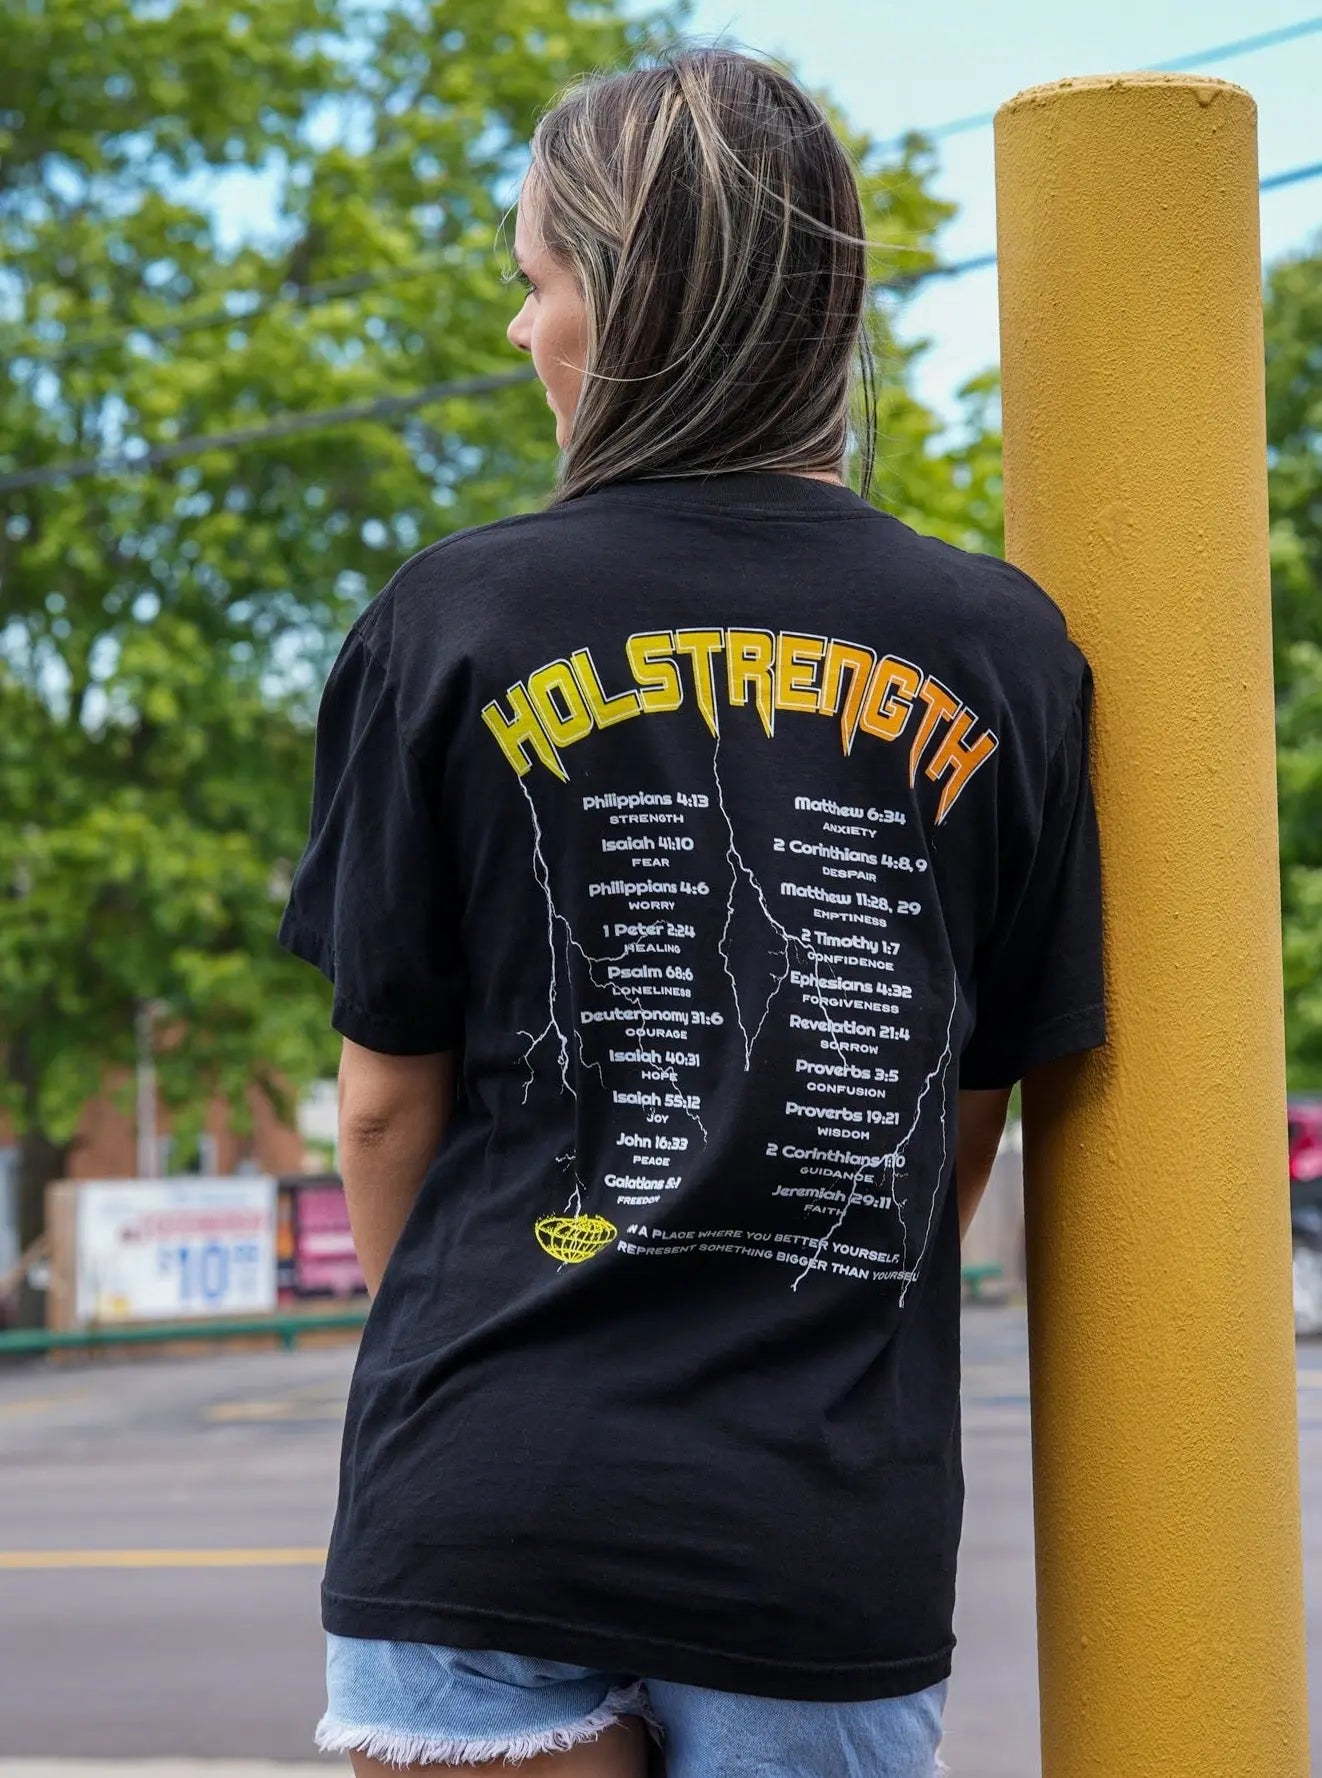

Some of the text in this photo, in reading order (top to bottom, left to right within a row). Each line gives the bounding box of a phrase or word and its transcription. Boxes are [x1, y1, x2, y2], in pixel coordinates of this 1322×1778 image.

[583, 791, 709, 810] Philippians 4:13
[609, 814, 684, 824] STRENGTH
[795, 796, 906, 825] Matthew 6:34
[823, 822, 877, 838] ANXIETY
[602, 836, 694, 852] Isaiah 41:10
[632, 858, 670, 867] FEAR
[773, 838, 928, 872] 2 Corinthians 4:8, 9
[822, 866, 877, 883] DESPAIR
[589, 880, 710, 897] Philippians 4:6
[629, 901, 675, 910] WORRY
[780, 882, 922, 916] Matthew 11:28, 29
[813, 908, 887, 928] EMPTINESS
[603, 922, 696, 938] 1 Peter 2:24
[624, 944, 681, 954] HEALING
[801, 928, 900, 956] 2 Timothy 1:7
[807, 952, 895, 971] CONFIDENCE
[608, 965, 694, 981] Psalm 68:6
[612, 986, 692, 998] LONELINESS
[790, 970, 913, 999] Ephesians 4:32
[802, 994, 900, 1015] FORGIVENESS
[580, 1008, 724, 1026] Deuteronomy 31:6
[625, 1028, 688, 1040] COURAGE
[789, 1014, 911, 1042] Revelation 21:4
[820, 1039, 879, 1055] SORROW
[609, 1049, 700, 1067] Isaiah 40:31
[641, 1070, 678, 1082] HOPE
[795, 1058, 899, 1083] Proverbs 3:5
[806, 1082, 886, 1099] CONFUSION
[612, 1090, 701, 1110] Isaiah 55:12
[646, 1114, 669, 1124] JOY
[785, 1101, 900, 1125] Proverbs 19:21
[616, 1132, 689, 1150] John 16:33
[817, 1126, 870, 1141] WISDOM
[632, 1154, 671, 1167] PEACE
[765, 1142, 778, 1157] 2
[782, 1145, 880, 1168] Corinthians
[604, 1174, 665, 1190] Galatians
[800, 1166, 875, 1184] GUIDANCE
[772, 1185, 892, 1210] Jeremiah 29:11
[803, 1204, 847, 1217] FAITH
[638, 1225, 648, 1238] A
[652, 1228, 696, 1240] PLACE
[698, 1230, 743, 1239] WHERE
[746, 1231, 772, 1242] YOU
[774, 1233, 829, 1251] BETTER
[832, 1242, 900, 1264] YOURSELF,
[617, 1240, 697, 1256] REPRESENT
[698, 1243, 773, 1259] SOMETHING
[776, 1251, 827, 1271] BIGGER
[831, 1262, 869, 1280] THAN
